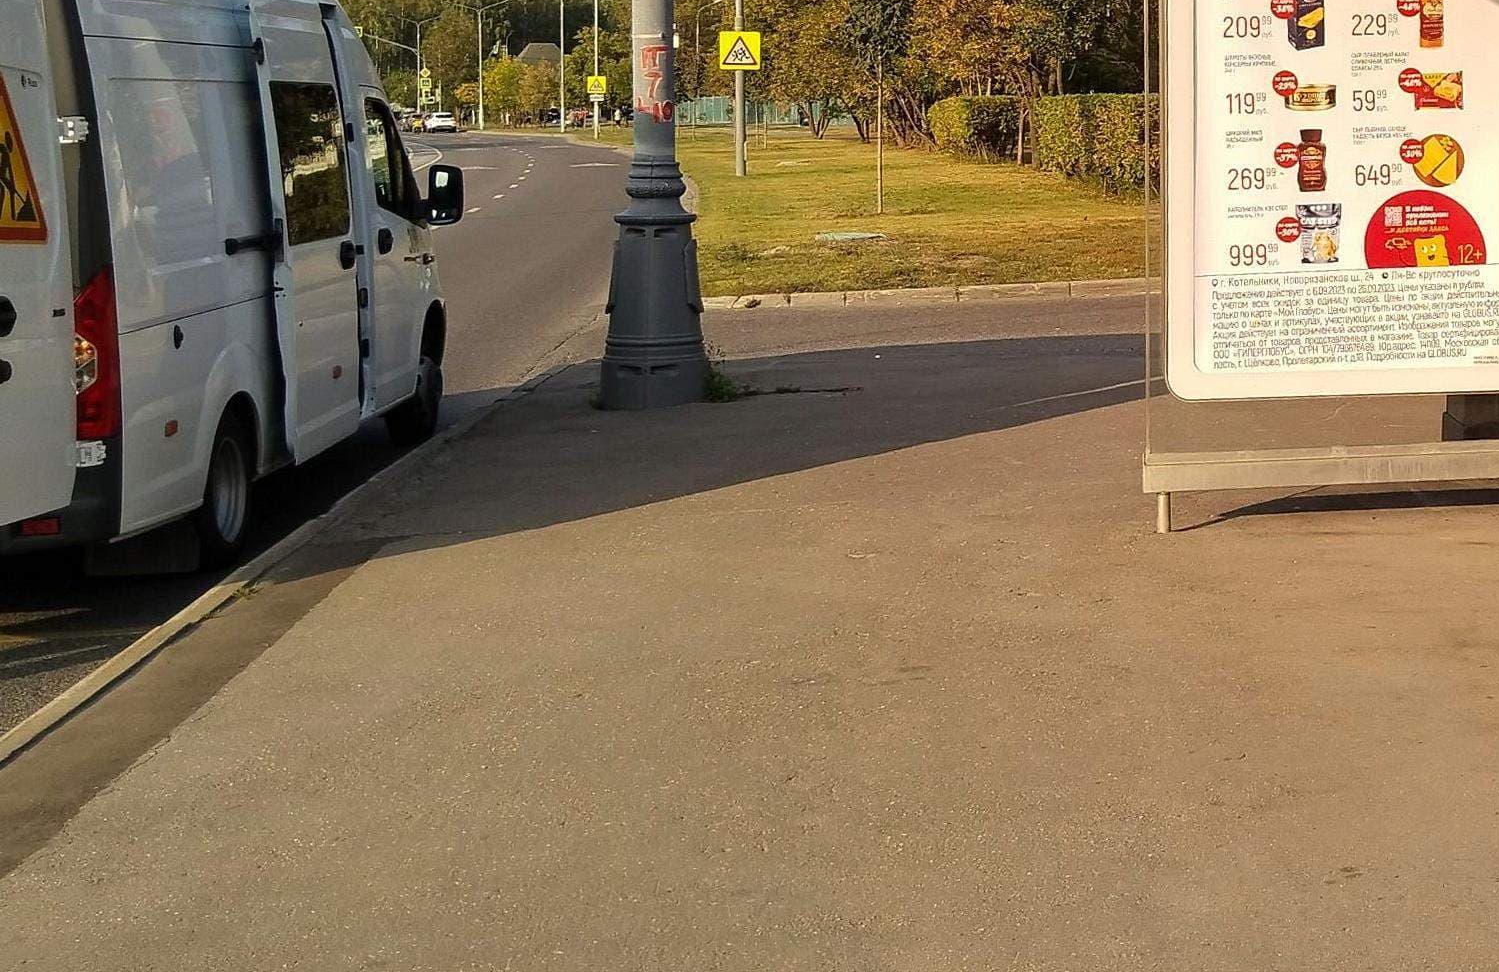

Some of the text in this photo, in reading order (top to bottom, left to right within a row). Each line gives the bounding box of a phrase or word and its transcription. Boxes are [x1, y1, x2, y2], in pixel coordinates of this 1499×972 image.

[1223, 16, 1261, 38] 209
[1352, 14, 1387, 36] 229
[1226, 92, 1255, 114] 119
[1352, 90, 1376, 111] 59
[1228, 168, 1265, 190] 269
[1355, 164, 1391, 186] 649
[1229, 244, 1267, 267] 999
[1458, 243, 1483, 264] 12+
